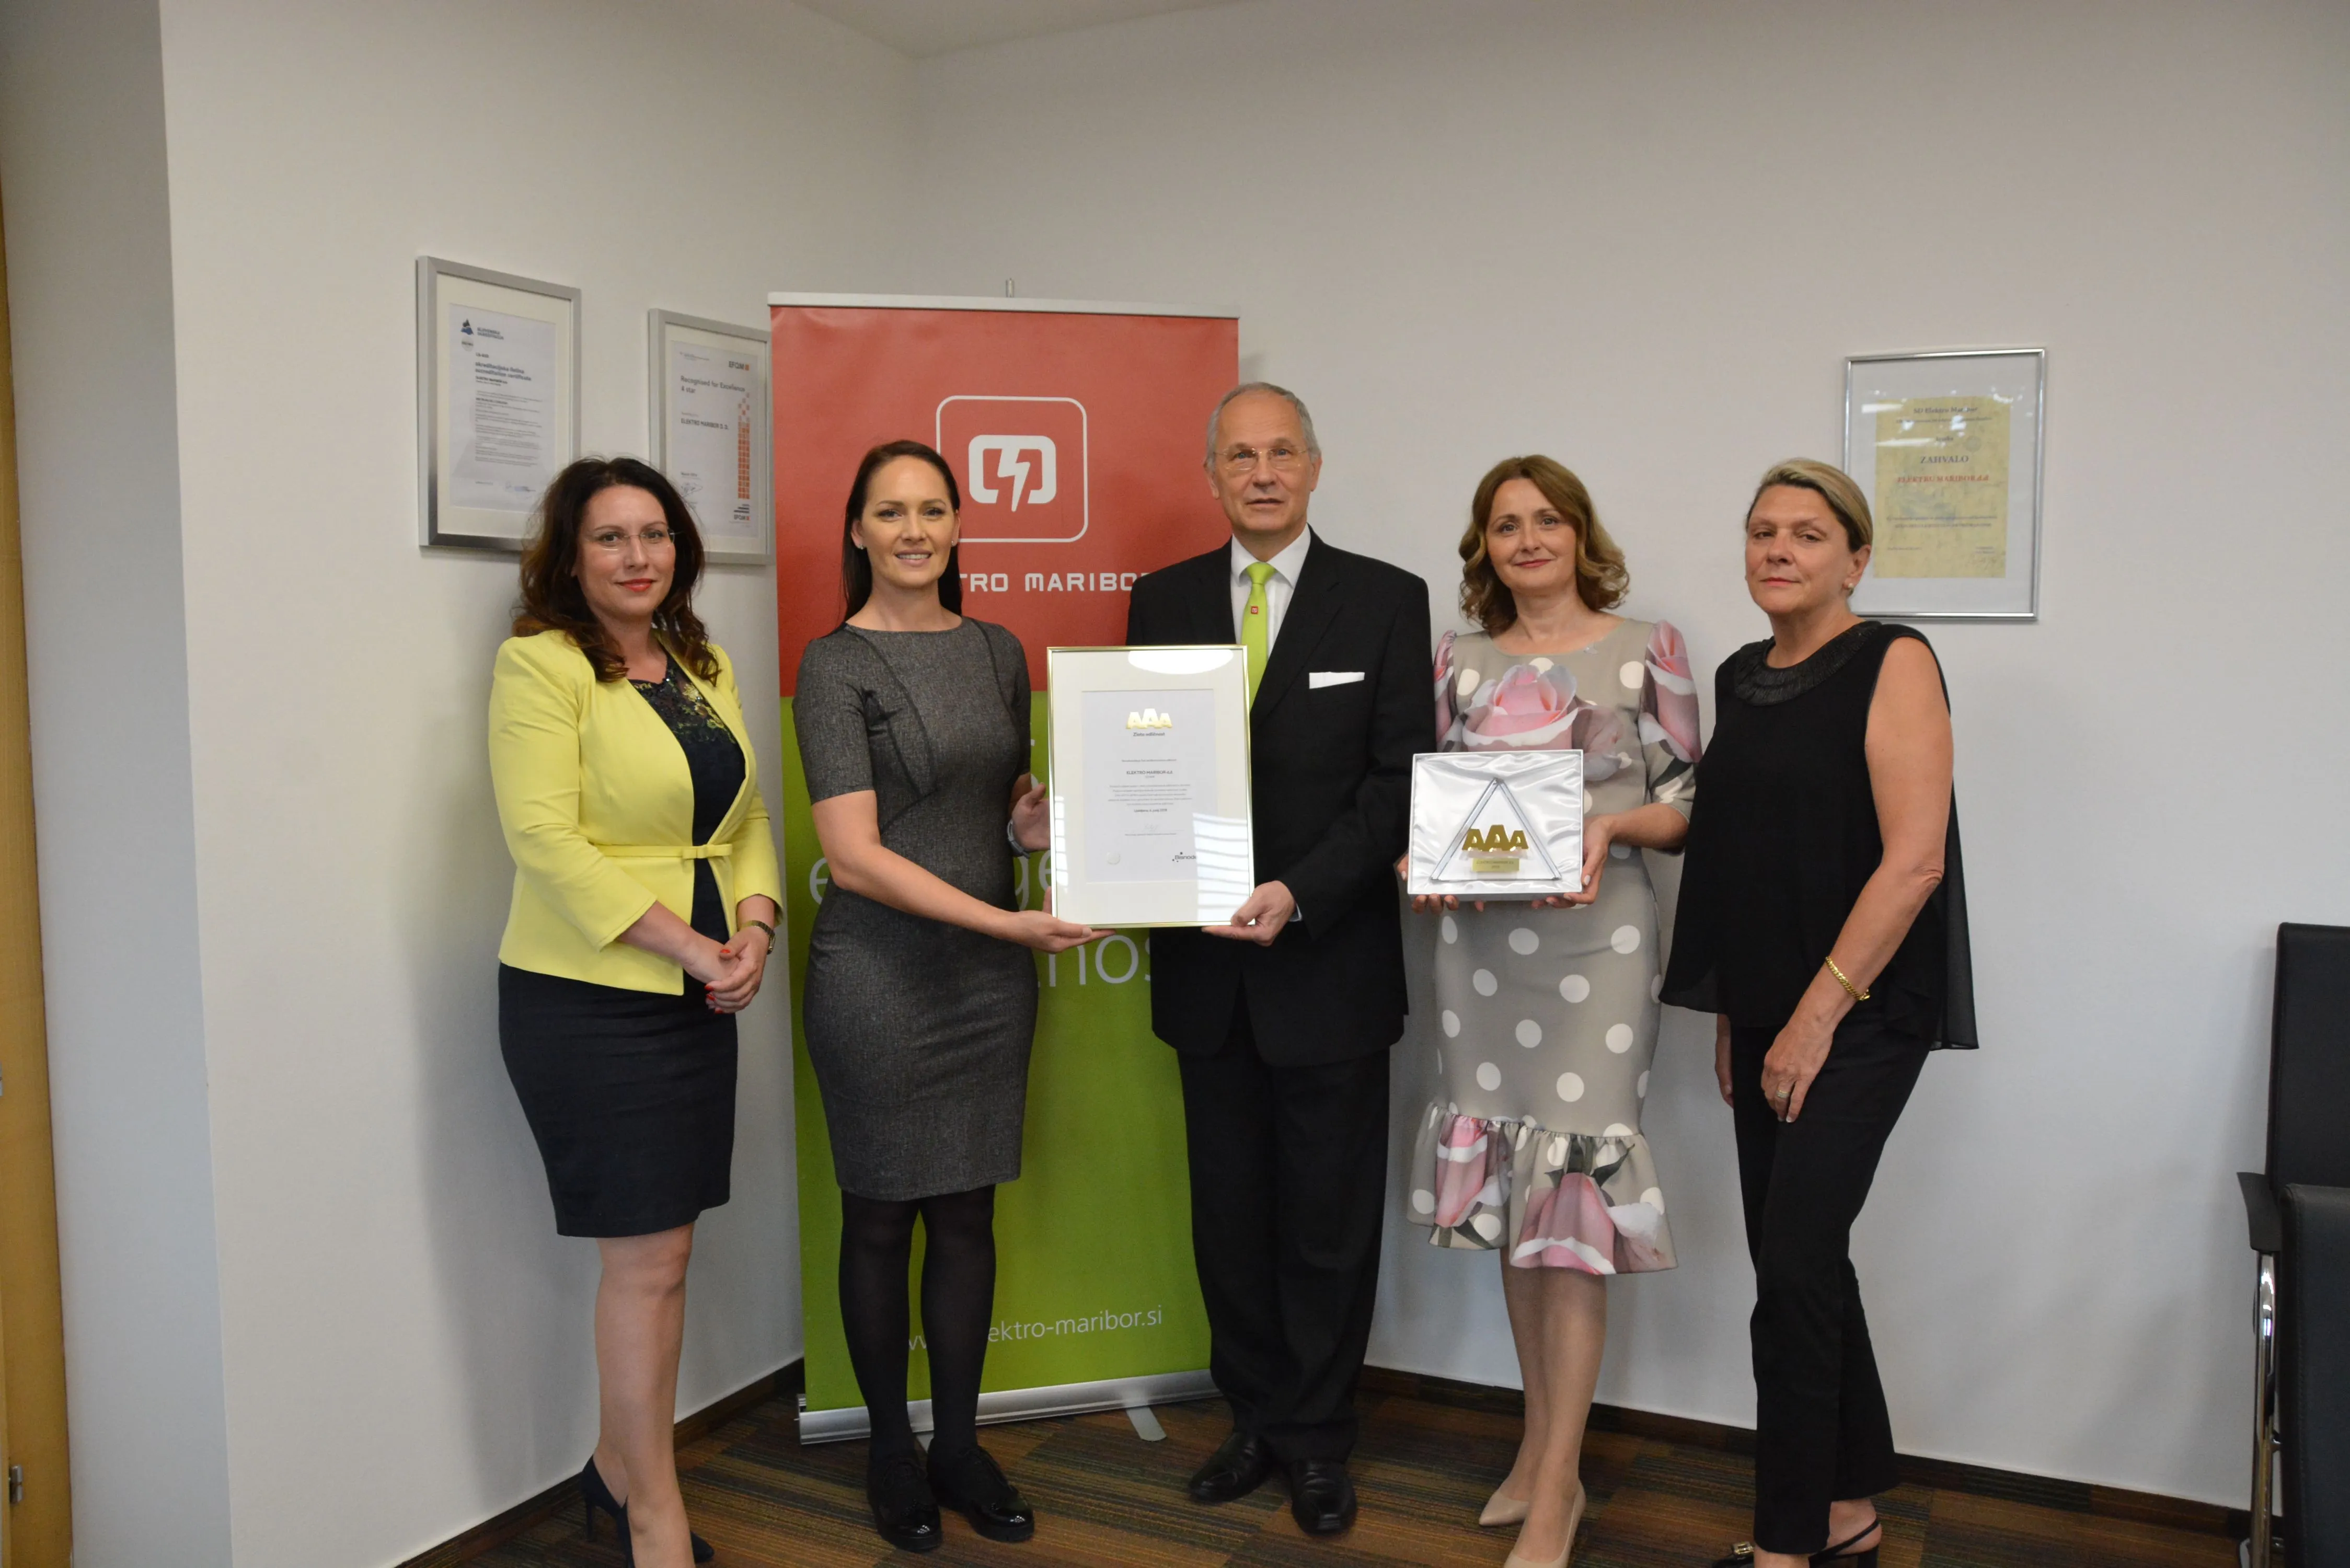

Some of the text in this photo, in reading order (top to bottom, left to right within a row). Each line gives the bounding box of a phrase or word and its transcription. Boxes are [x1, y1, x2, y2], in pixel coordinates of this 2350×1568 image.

[729, 361, 744, 370] EFQM
[681, 375, 710, 386] Recognised
[720, 382, 745, 392] Excellence
[1920, 455, 1969, 464] ZAHVALO
[1025, 572, 1149, 592] MARIBO
[1125, 708, 1172, 730] AAA
[1461, 824, 1529, 852] AAA
